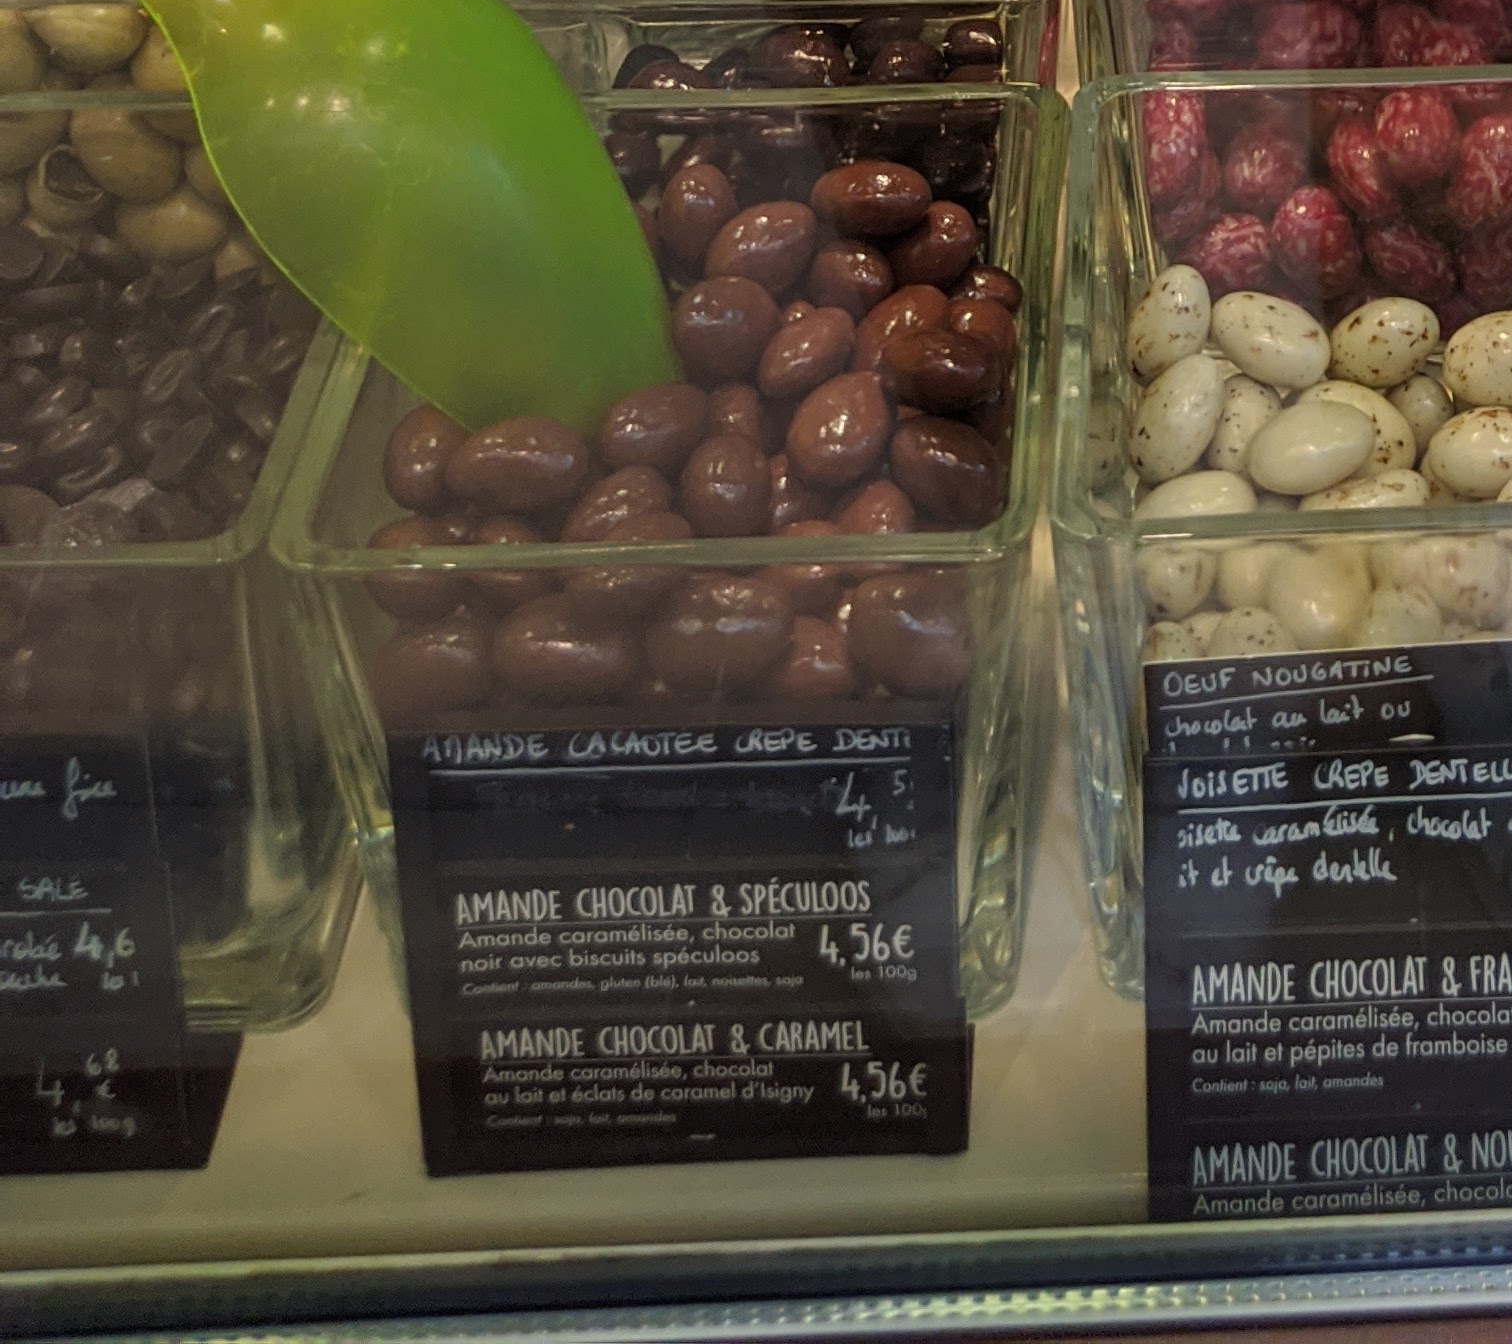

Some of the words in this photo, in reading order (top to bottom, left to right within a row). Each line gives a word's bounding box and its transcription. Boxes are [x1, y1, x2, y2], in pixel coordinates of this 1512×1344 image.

[1163, 664, 1235, 699] OEUF
[733, 726, 818, 755] CREPE
[1313, 760, 1390, 791] CREPE
[454, 888, 563, 925] AMANDE
[574, 882, 697, 920] CHOCOLAT
[711, 884, 733, 917] &
[739, 876, 872, 914] SPÉCULOOS
[457, 927, 552, 950] Amande
[558, 922, 695, 949] caramélisée,
[701, 920, 796, 941] chocolat
[459, 951, 502, 973] noir
[508, 952, 563, 970] avec
[568, 946, 647, 969] biscuits
[652, 944, 760, 972] spéculoos
[849, 965, 873, 982] les
[877, 964, 918, 983] 100g
[1192, 963, 1296, 1004] AMANDE
[1309, 956, 1428, 999] CHOCOLAT
[1442, 960, 1462, 993] &
[1191, 1011, 1283, 1035] Amande
[1288, 1007, 1421, 1034] caramélisée,
[479, 1025, 586, 1060] AMANDE
[599, 1023, 716, 1056] CHOCOLAT
[730, 1024, 751, 1054] &
[758, 1019, 869, 1054] CARAMEL
[1192, 1045, 1218, 1064] au
[1225, 1040, 1257, 1063] lait
[1263, 1040, 1284, 1061] et
[1290, 1036, 1367, 1067] pépites
[1372, 1034, 1400, 1057] de
[1404, 1032, 1509, 1055] framboise
[482, 1061, 566, 1081] Amande
[569, 1058, 688, 1082] caramélisée,
[692, 1058, 774, 1078] chocolat
[484, 1089, 508, 1105] au
[512, 1084, 543, 1104] lait
[547, 1084, 567, 1103] et
[571, 1080, 626, 1103] éclats
[629, 1081, 656, 1101] de
[660, 1080, 737, 1100] caramel
[1192, 1141, 1297, 1189] AMANDE
[1310, 1134, 1429, 1177] CHOCOLAT
[1443, 1134, 1463, 1173] &
[1193, 1191, 1286, 1214] Amande
[1291, 1185, 1428, 1211] caramélisée,
